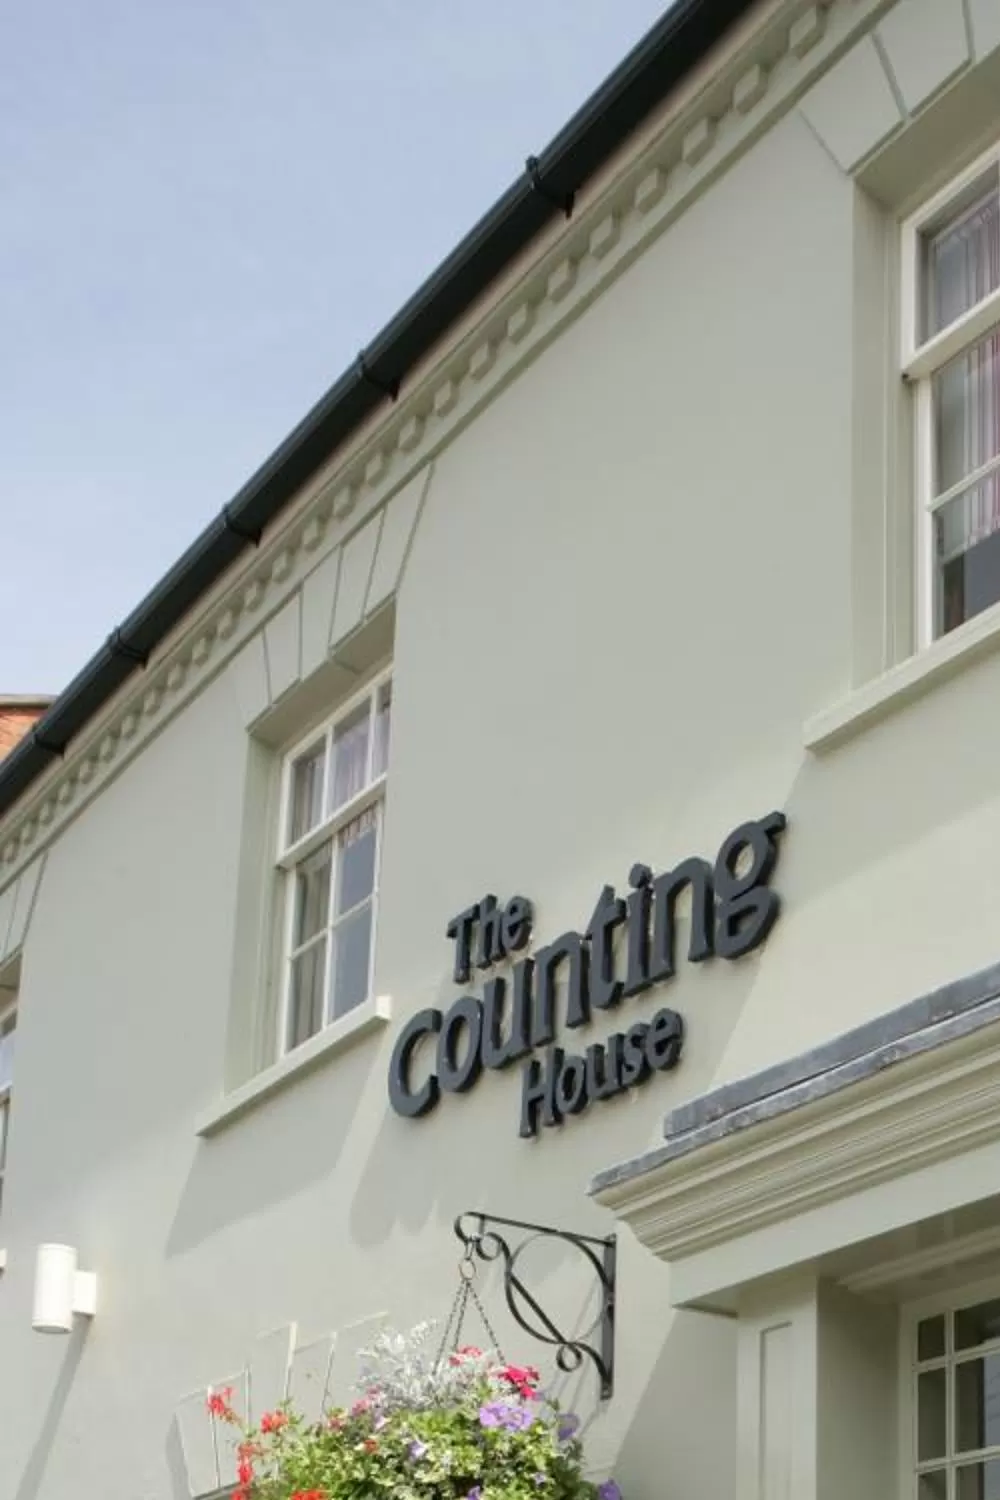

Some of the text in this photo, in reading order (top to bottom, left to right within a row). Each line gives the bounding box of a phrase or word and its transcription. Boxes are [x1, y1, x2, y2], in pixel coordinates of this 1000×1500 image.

[389, 811, 787, 1118] Counting
[447, 894, 534, 983] The
[519, 1007, 684, 1138] House
